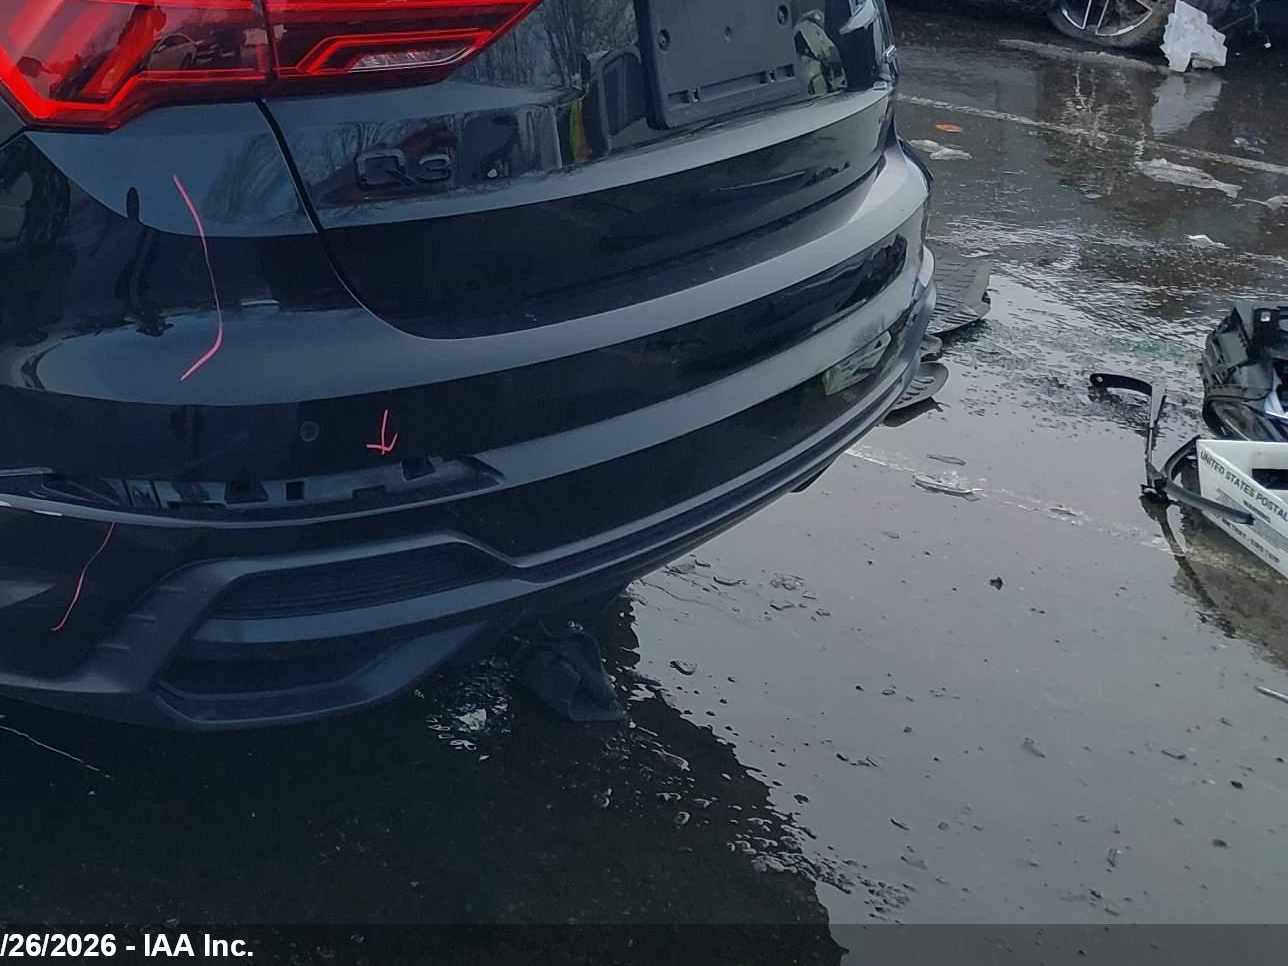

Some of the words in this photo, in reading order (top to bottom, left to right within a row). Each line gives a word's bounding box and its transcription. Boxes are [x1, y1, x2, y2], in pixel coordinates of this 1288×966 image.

[355, 147, 452, 189] Q3
[1200, 450, 1225, 475] UNITED
[1225, 470, 1256, 498] STATES
[1256, 493, 1288, 522] POSTAL
